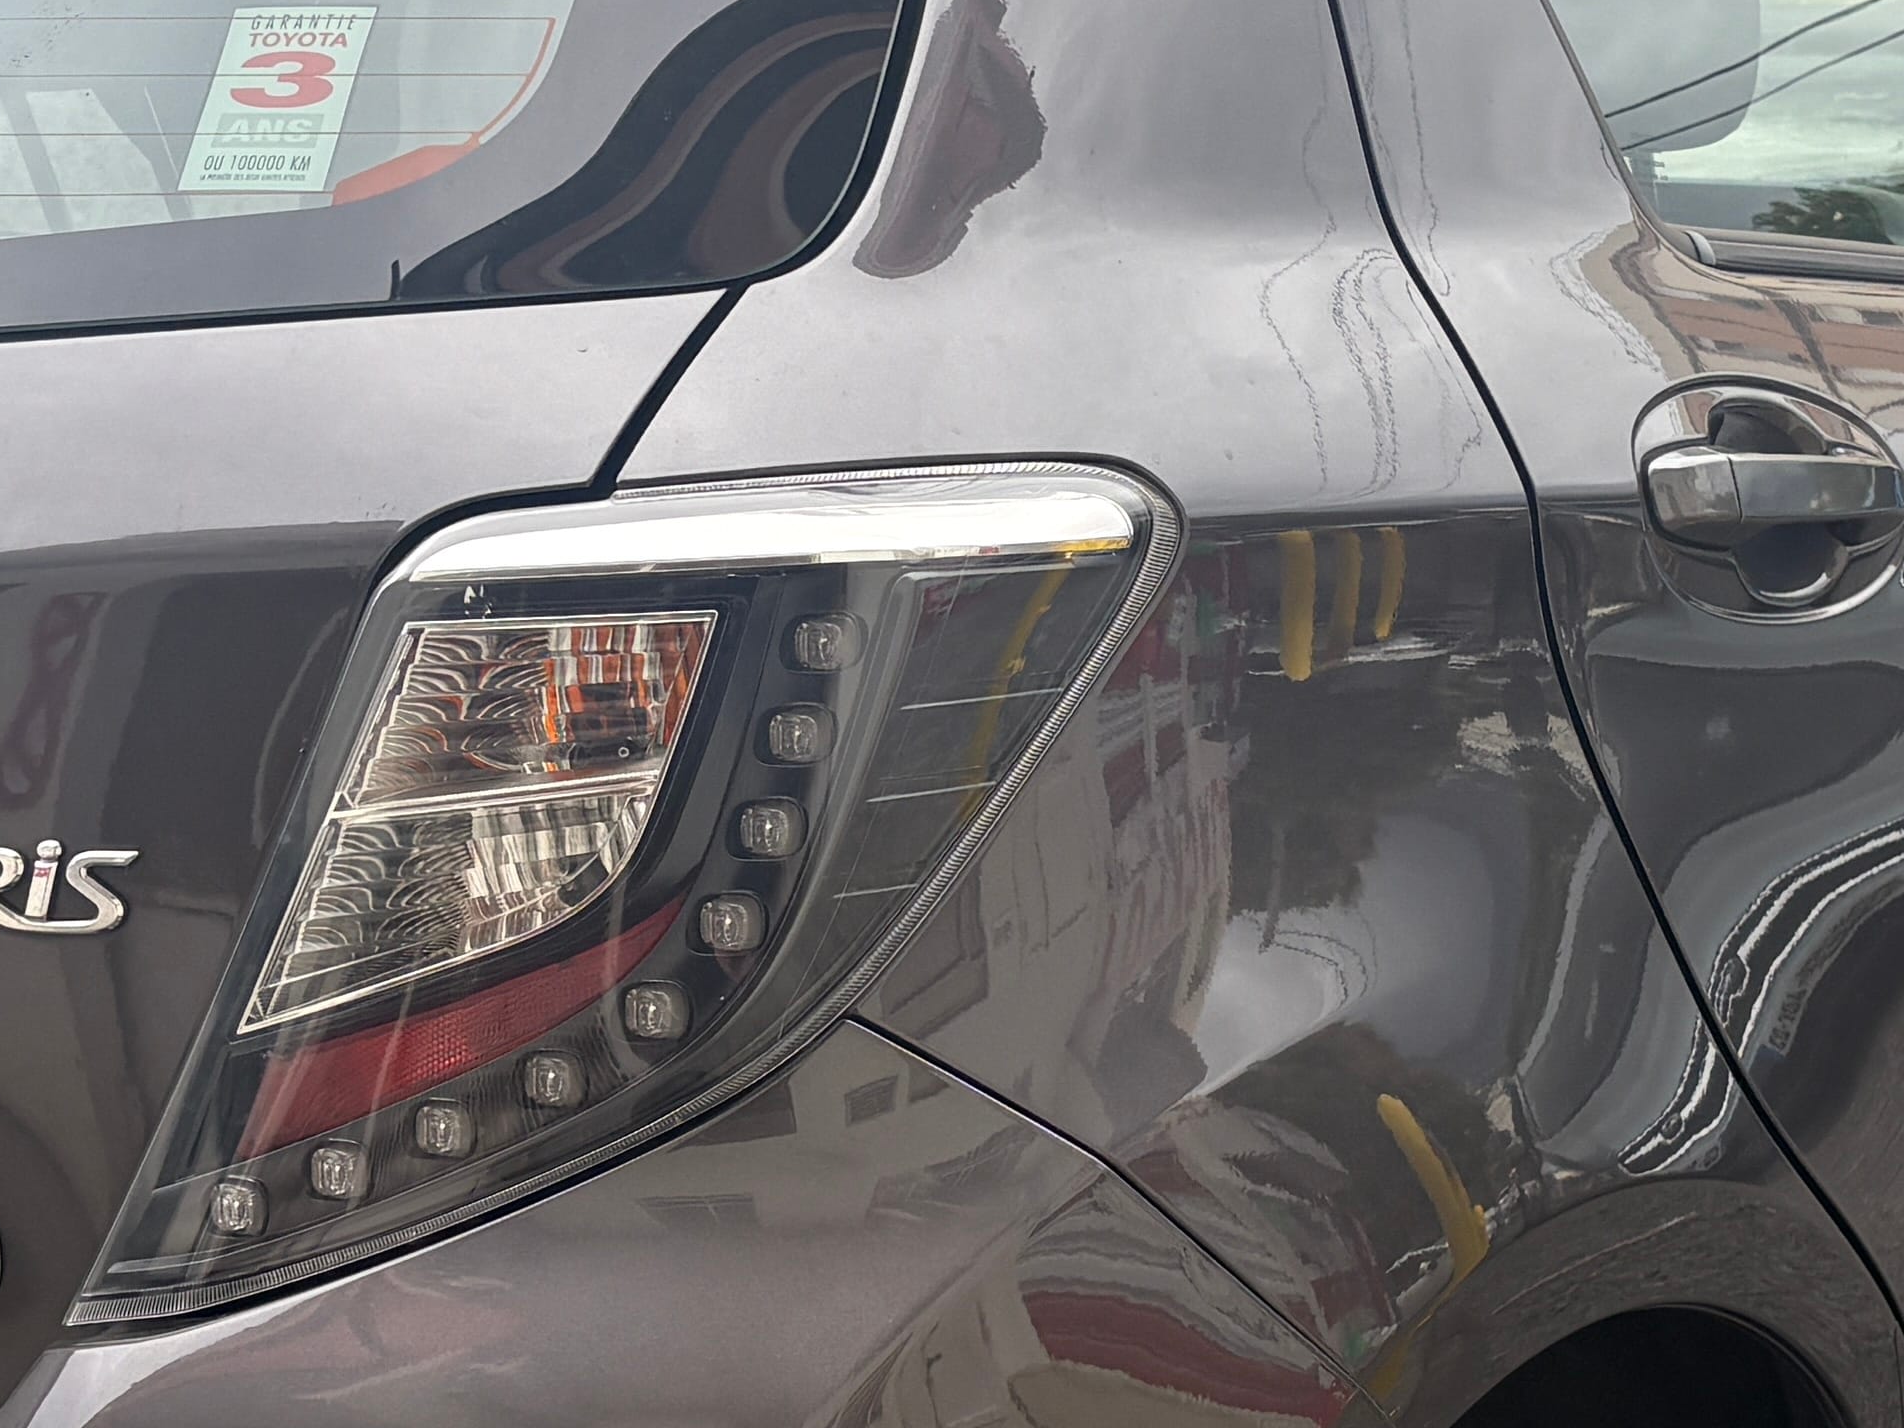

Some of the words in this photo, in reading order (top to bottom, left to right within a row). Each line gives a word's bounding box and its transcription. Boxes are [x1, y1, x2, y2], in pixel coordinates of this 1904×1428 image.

[251, 14, 357, 31] GARANTIE
[248, 31, 349, 49] TOYOTA
[229, 50, 337, 109] 3
[221, 116, 315, 145] ANS
[203, 154, 226, 171] OU
[229, 155, 287, 172] 100000
[289, 155, 312, 172] KM
